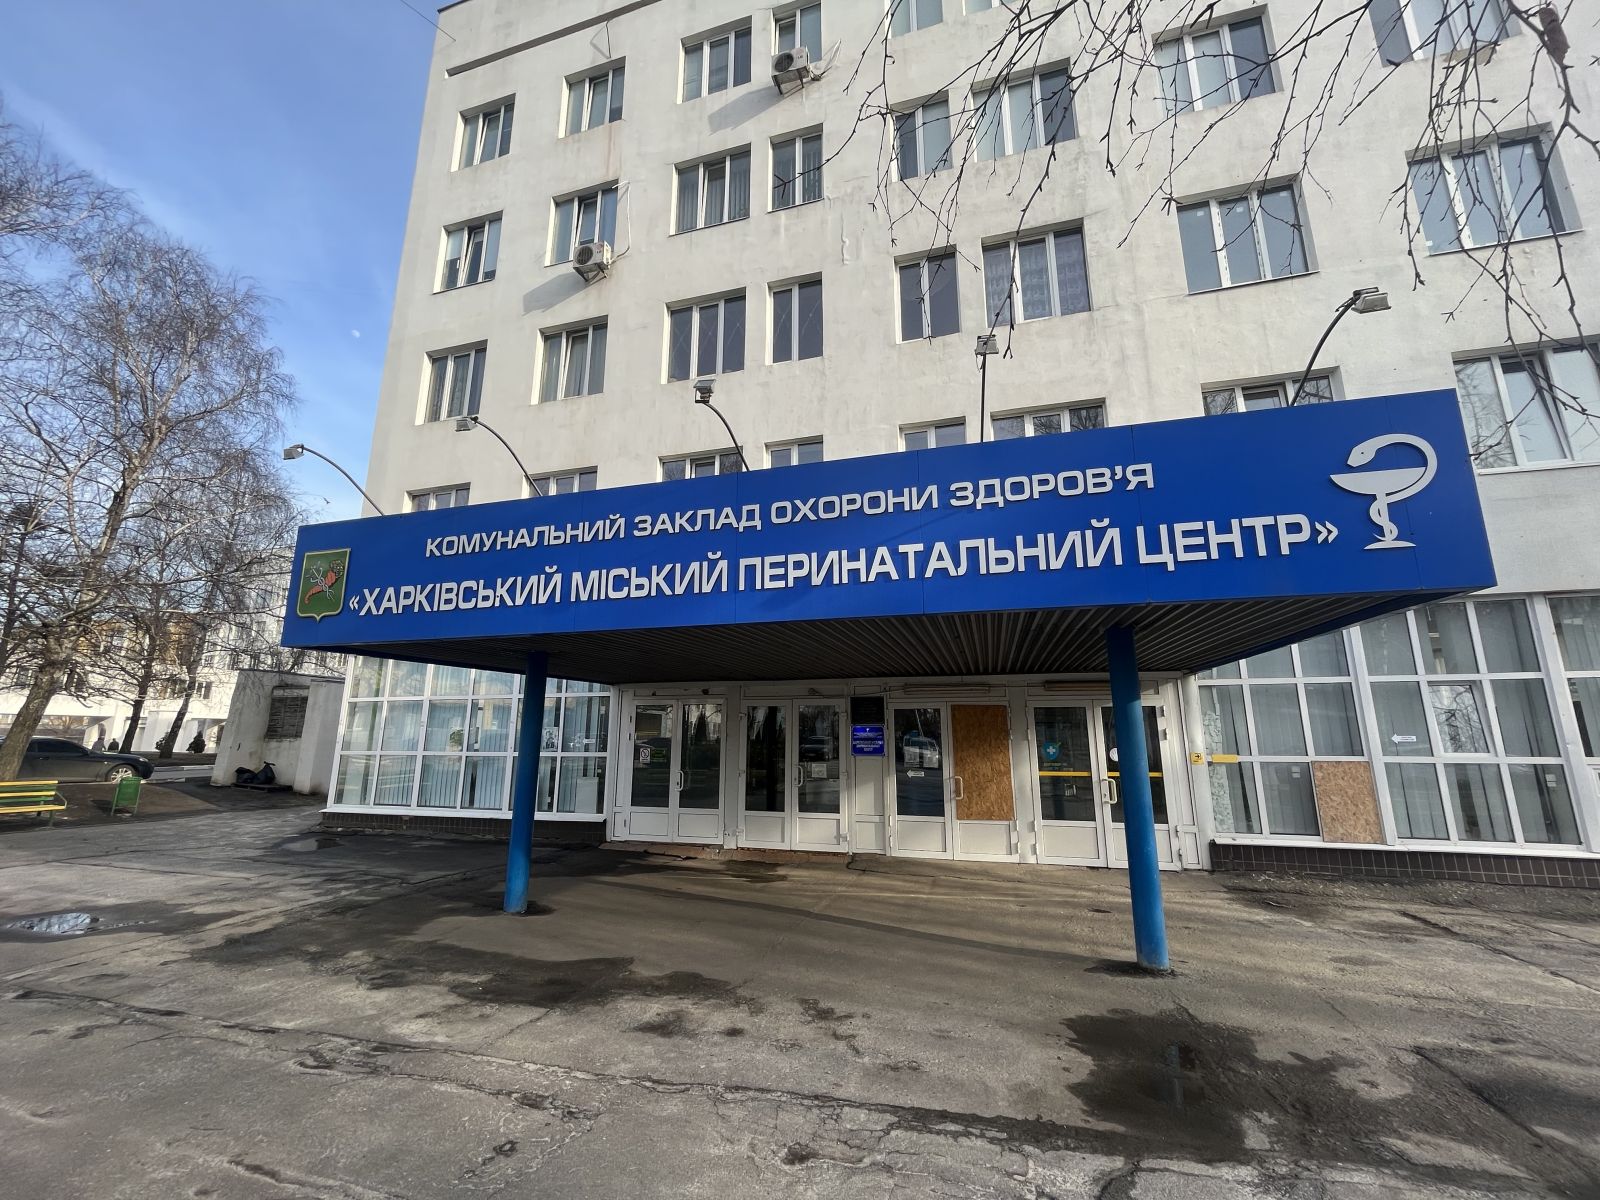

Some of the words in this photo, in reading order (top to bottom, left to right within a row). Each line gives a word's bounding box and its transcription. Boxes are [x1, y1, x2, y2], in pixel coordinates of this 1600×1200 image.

[348, 565, 563, 617] «ХАРКІВСЬКИЙ
[570, 550, 728, 603] МІСЬКИЙ
[738, 517, 1123, 591] ПЕРИНАТАЛЬНИЙ
[1136, 513, 1340, 572] ЦЕНТР»
[425, 513, 626, 559] КОМУНАЛЬНИЙ
[633, 504, 762, 537] ЗАКЛАД
[770, 483, 939, 525] ОХОРОНИ
